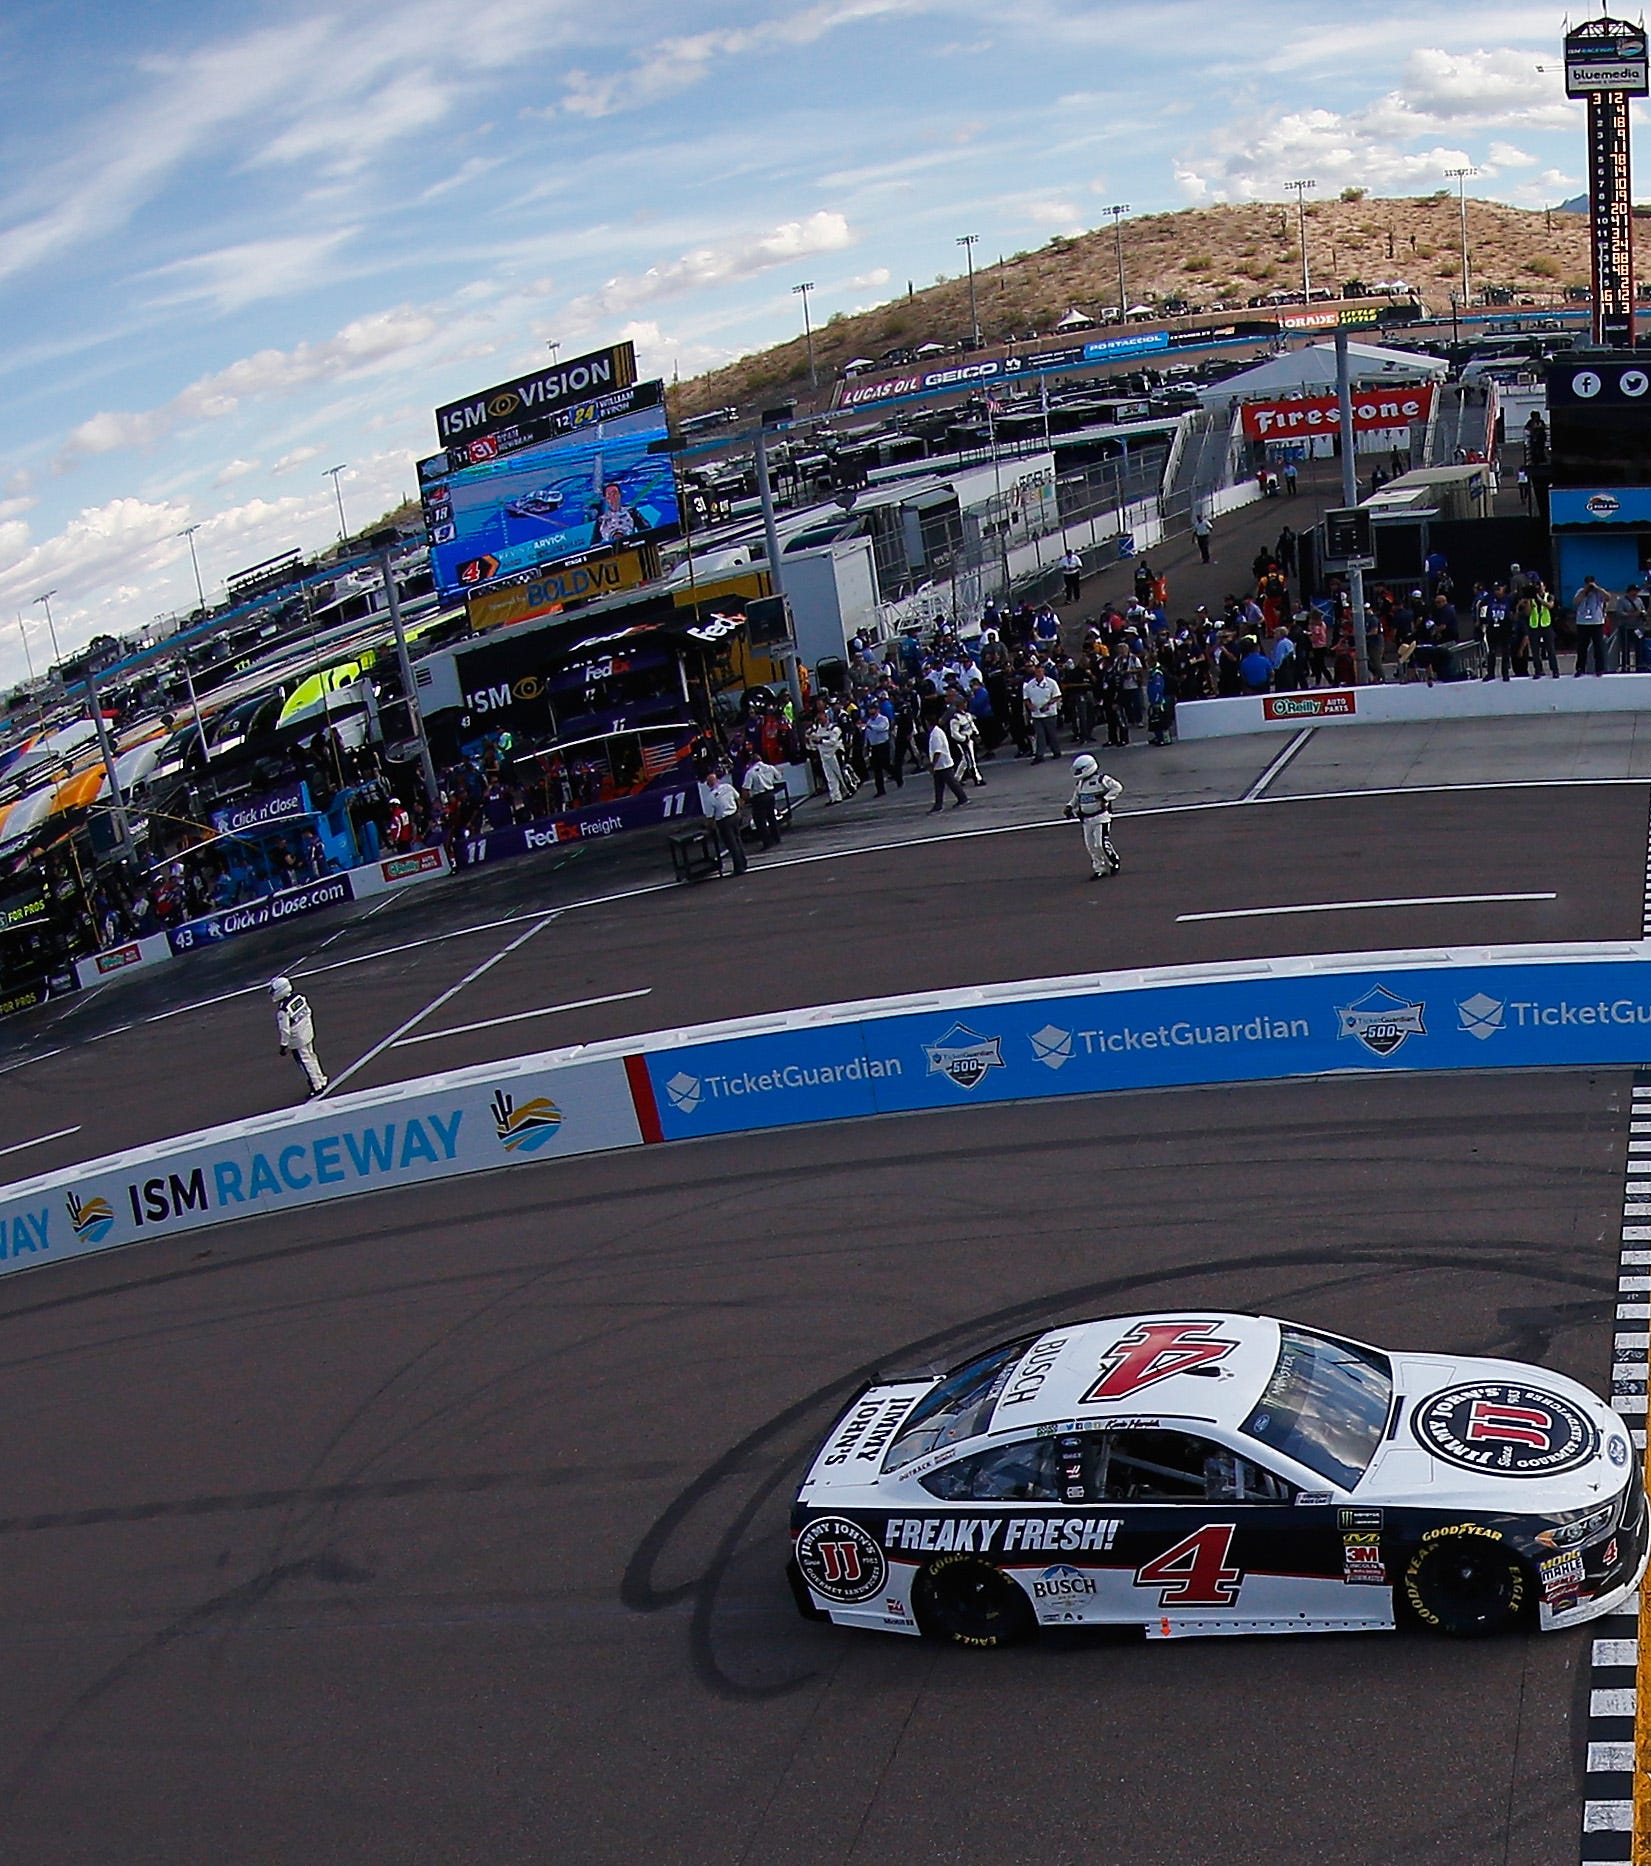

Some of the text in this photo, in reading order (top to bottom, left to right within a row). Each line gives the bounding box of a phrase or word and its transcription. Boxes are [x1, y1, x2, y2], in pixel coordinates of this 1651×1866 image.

[1573, 68, 1639, 80] bluemedia
[1617, 105, 1625, 116] 4
[1614, 117, 1625, 128] 18
[1617, 129, 1625, 140] 9
[1615, 141, 1626, 152] 11
[1610, 154, 1626, 165] 78
[1615, 166, 1626, 177] 14
[1615, 178, 1626, 189] 10
[1616, 190, 1627, 201] 19
[1611, 203, 1627, 214] 20
[1612, 239, 1628, 251] 24
[1613, 252, 1628, 264] 88
[1612, 265, 1628, 276] 48
[1621, 277, 1629, 288] 2
[1618, 289, 1629, 300] 12
[1622, 302, 1629, 314] 3
[925, 362, 999, 386] GEICO
[442, 359, 611, 436] ISM VISION
[843, 378, 917, 404] LUCAS OIL
[556, 416, 569, 428] 12
[574, 408, 594, 424] 24
[1254, 400, 1420, 434] Firesone
[471, 441, 493, 459] 31
[462, 562, 480, 583] 4
[585, 659, 630, 682] FedEx
[466, 683, 512, 714] ISM
[1273, 699, 1321, 716] O'Reilly
[1324, 705, 1349, 713] PARTS
[1327, 698, 1346, 706] AUTO
[232, 807, 257, 828] Click
[270, 795, 298, 816] Close
[662, 791, 686, 817] 11
[524, 817, 622, 849] FedEx Freight
[466, 838, 487, 863] 11
[8, 899, 45, 922] FOR PROS
[176, 929, 193, 948] 43
[224, 912, 256, 933] Click
[272, 884, 344, 919] Close.com
[0, 992, 37, 1015] FOR PROS
[1078, 1014, 1309, 1055] TicketGuardian
[705, 1053, 902, 1100] TicketGuardian
[128, 1109, 464, 1226] ISM RACEWAY
[1007, 1338, 1069, 1407] BUSCH
[1078, 1320, 1241, 1404] 4
[1272, 1355, 1295, 1396] MONSTER
[824, 1397, 916, 1466] JIMMY JOHN'S
[1429, 1387, 1501, 1465] JIMMY JOHN'S
[1516, 1392, 1582, 1468] GOURMET SANDWICHES
[801, 1522, 876, 1557] JIMMY JOHN'S
[885, 1519, 1120, 1552] FREAKY FRESH!
[1422, 1522, 1503, 1542] GOODYEAR
[818, 1541, 861, 1582] JJ
[1347, 1547, 1377, 1561] 3M
[1540, 1549, 1580, 1570] MOOG
[1602, 1537, 1618, 1566] 4
[1133, 1523, 1245, 1609] 4
[1542, 1558, 1583, 1580] MAHLE
[807, 1567, 842, 1595] GOURMET
[1033, 1578, 1097, 1599] BUSCH
[1405, 1543, 1440, 1625] GOODYEAR
[1508, 1566, 1524, 1612] EAGLE
